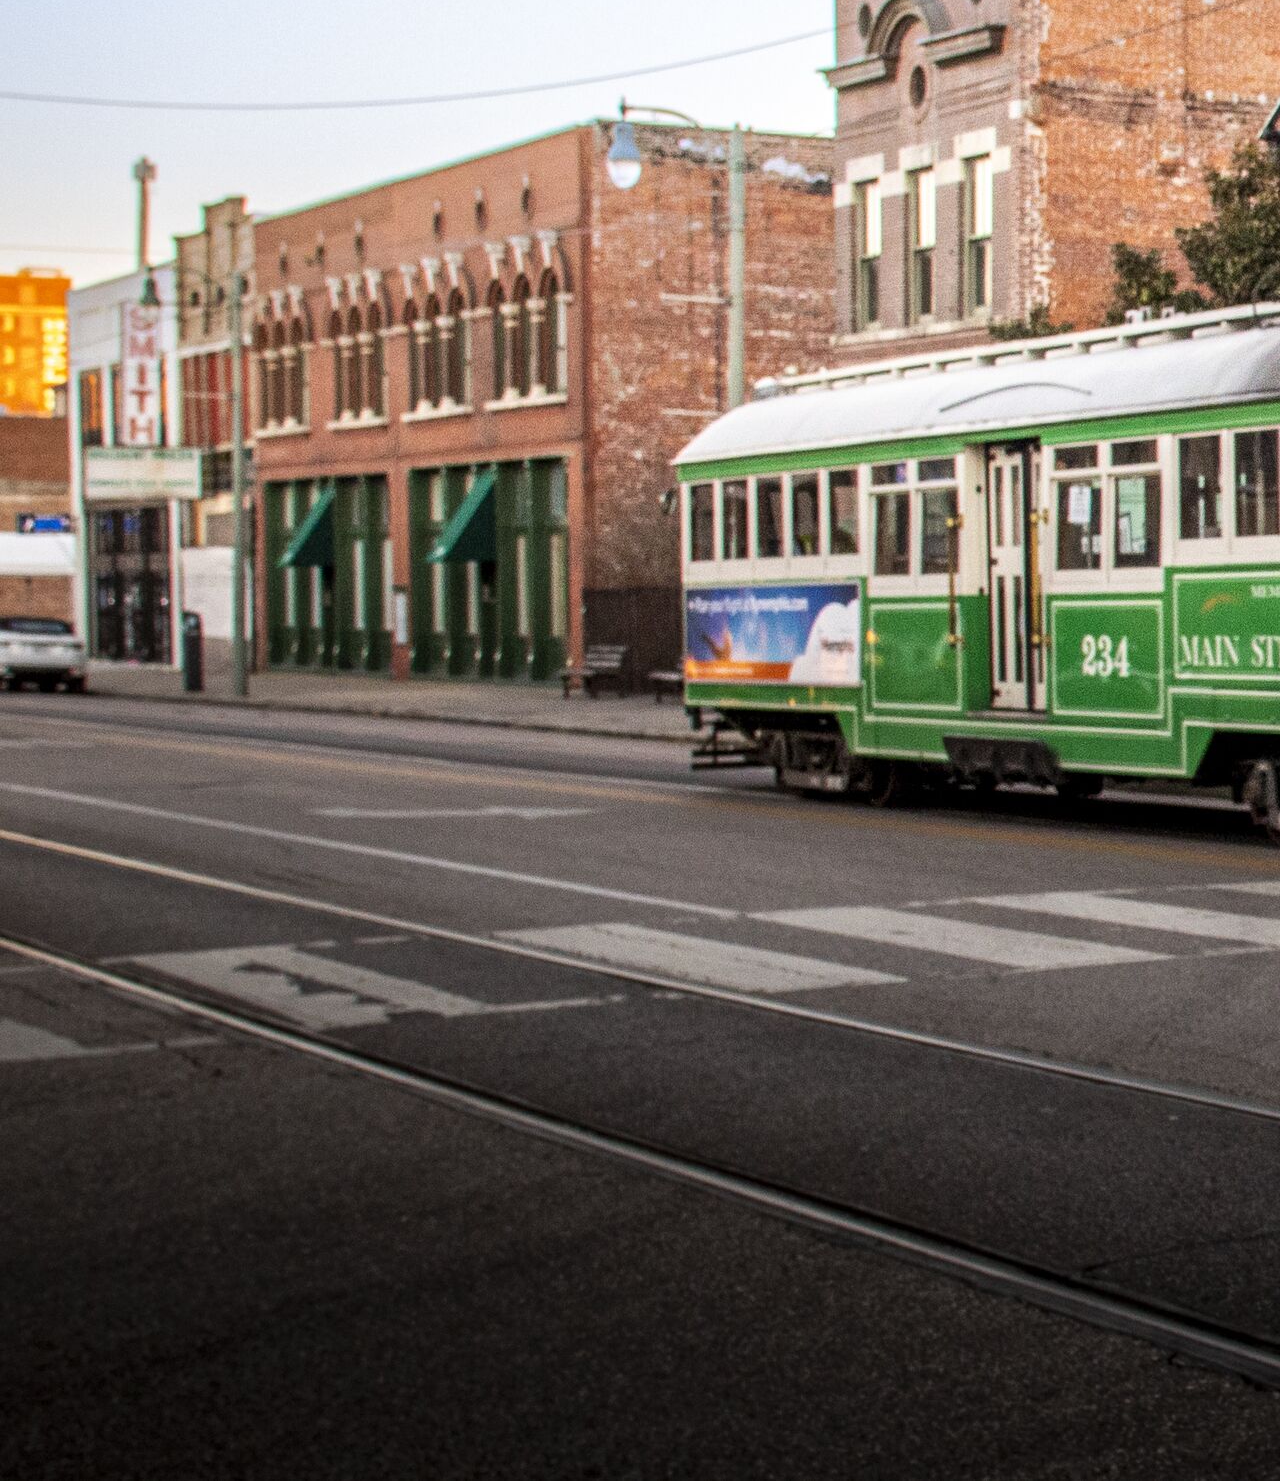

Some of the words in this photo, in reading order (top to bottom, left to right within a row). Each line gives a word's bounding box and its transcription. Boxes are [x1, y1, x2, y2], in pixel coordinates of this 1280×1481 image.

[128, 305, 156, 442] SMITH
[1081, 634, 1131, 677] 234
[1178, 635, 1240, 667] MAIN
